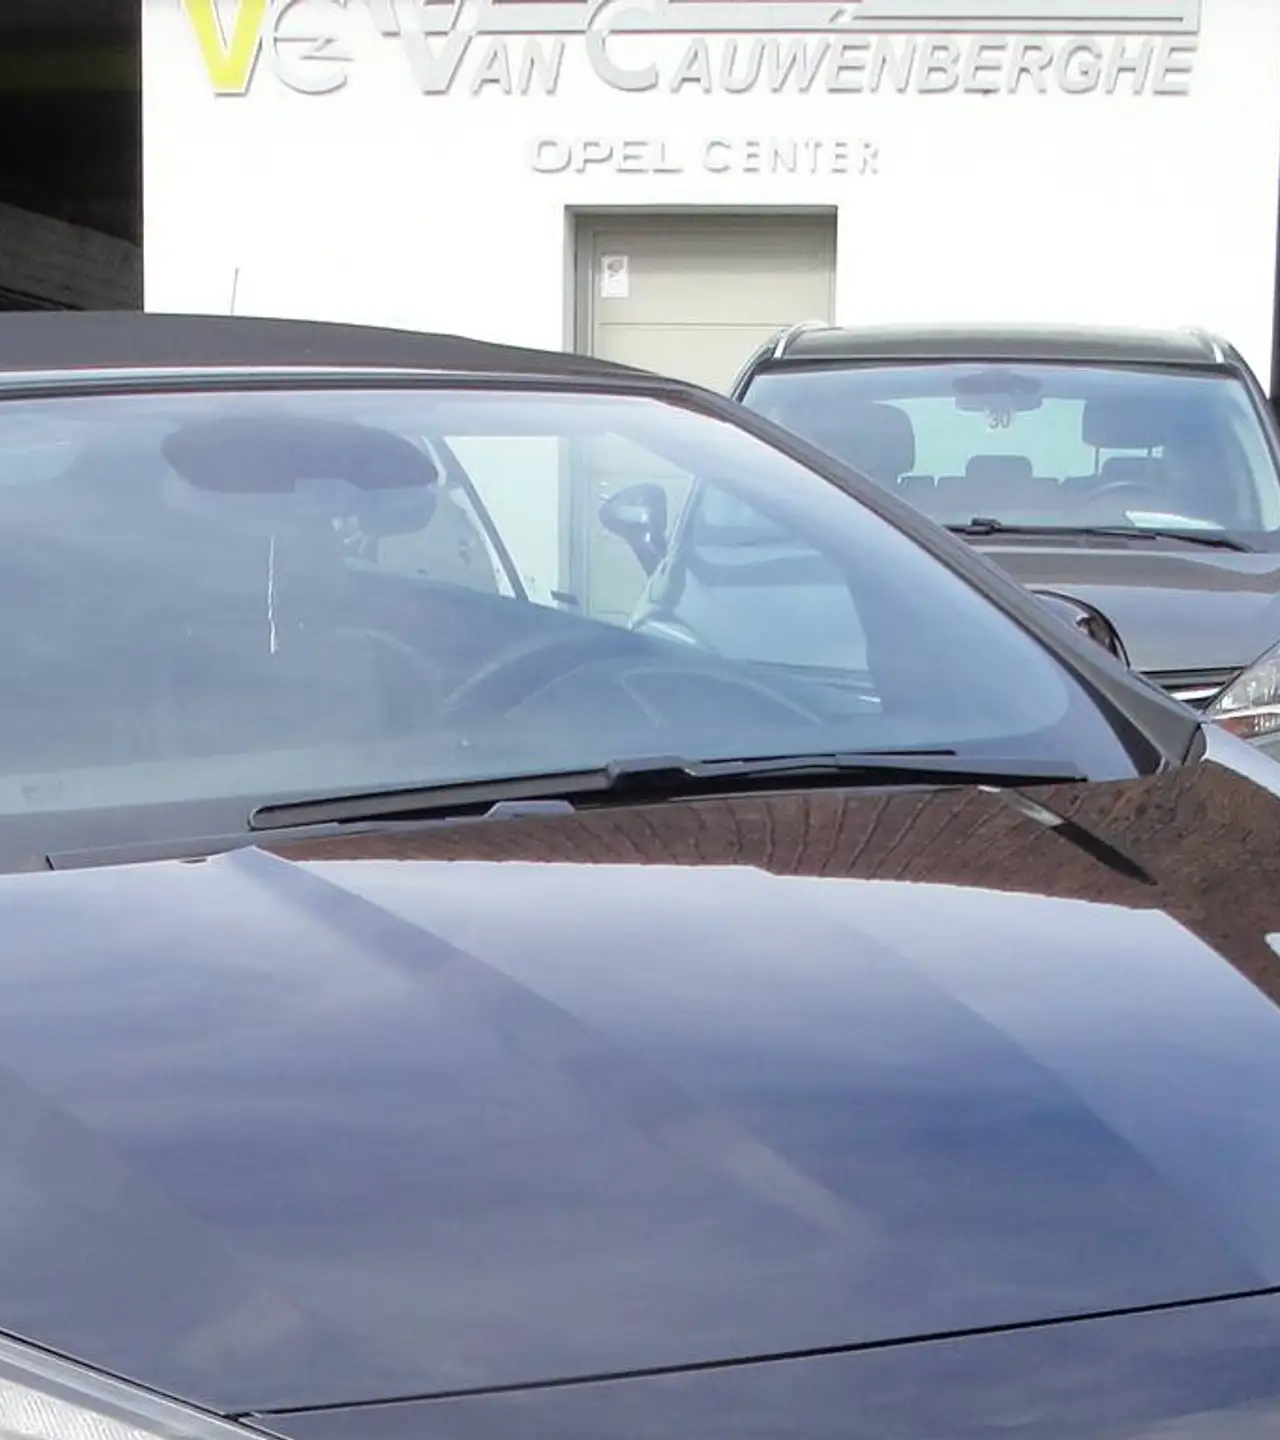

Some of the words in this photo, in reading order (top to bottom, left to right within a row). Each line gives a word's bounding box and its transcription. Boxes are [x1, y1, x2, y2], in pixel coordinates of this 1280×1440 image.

[368, 0, 565, 96] VAN
[585, 0, 1198, 96] CAUWENBERGHE
[528, 137, 685, 174] OPEL
[700, 137, 881, 176] CENTER
